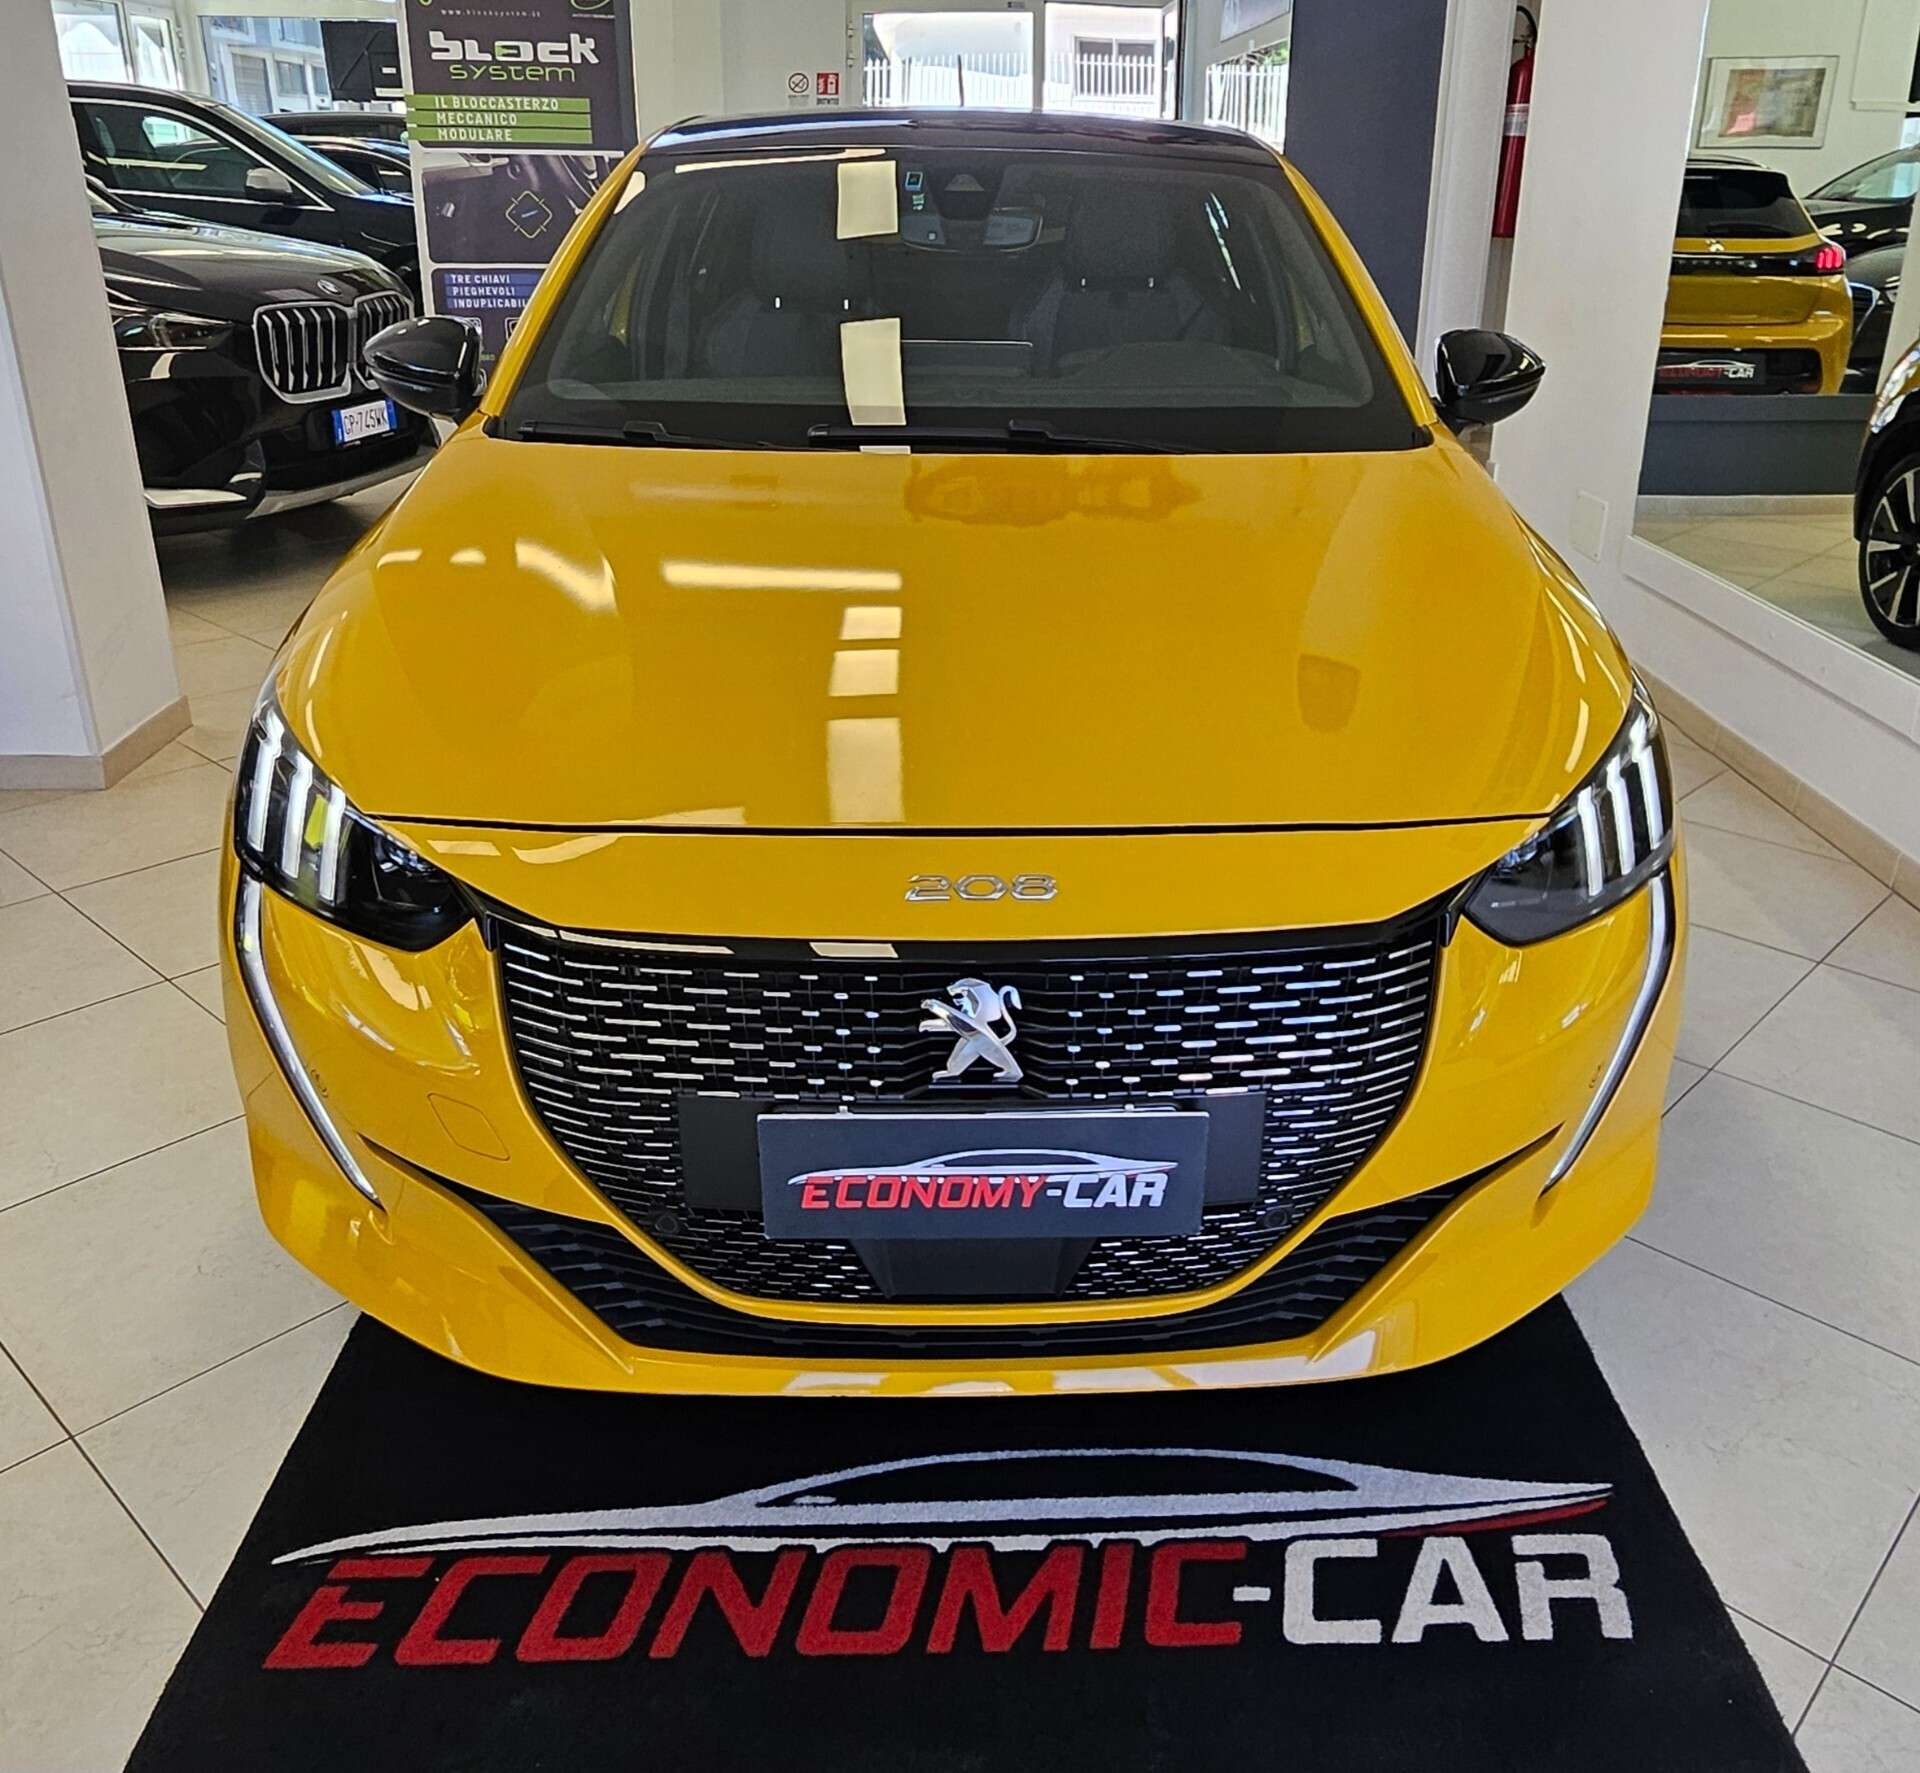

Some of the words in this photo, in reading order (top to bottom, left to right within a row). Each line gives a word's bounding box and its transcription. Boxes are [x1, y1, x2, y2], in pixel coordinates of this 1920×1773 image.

[434, 96, 448, 109] IL
[452, 96, 559, 111] BLOCCASTERZO
[436, 111, 517, 126] MECCANICO
[438, 128, 513, 141] MODULARE
[450, 273, 471, 284] TRE
[474, 274, 511, 285] CHIAVI
[452, 286, 516, 297] PIEGHEVOLI
[453, 298, 527, 309] INDUPLICABIL
[905, 874, 1059, 902] 208
[801, 1173, 1169, 1209] ECONOMY-CAR
[262, 1533, 1633, 1670] ECONOMIC-CAR
